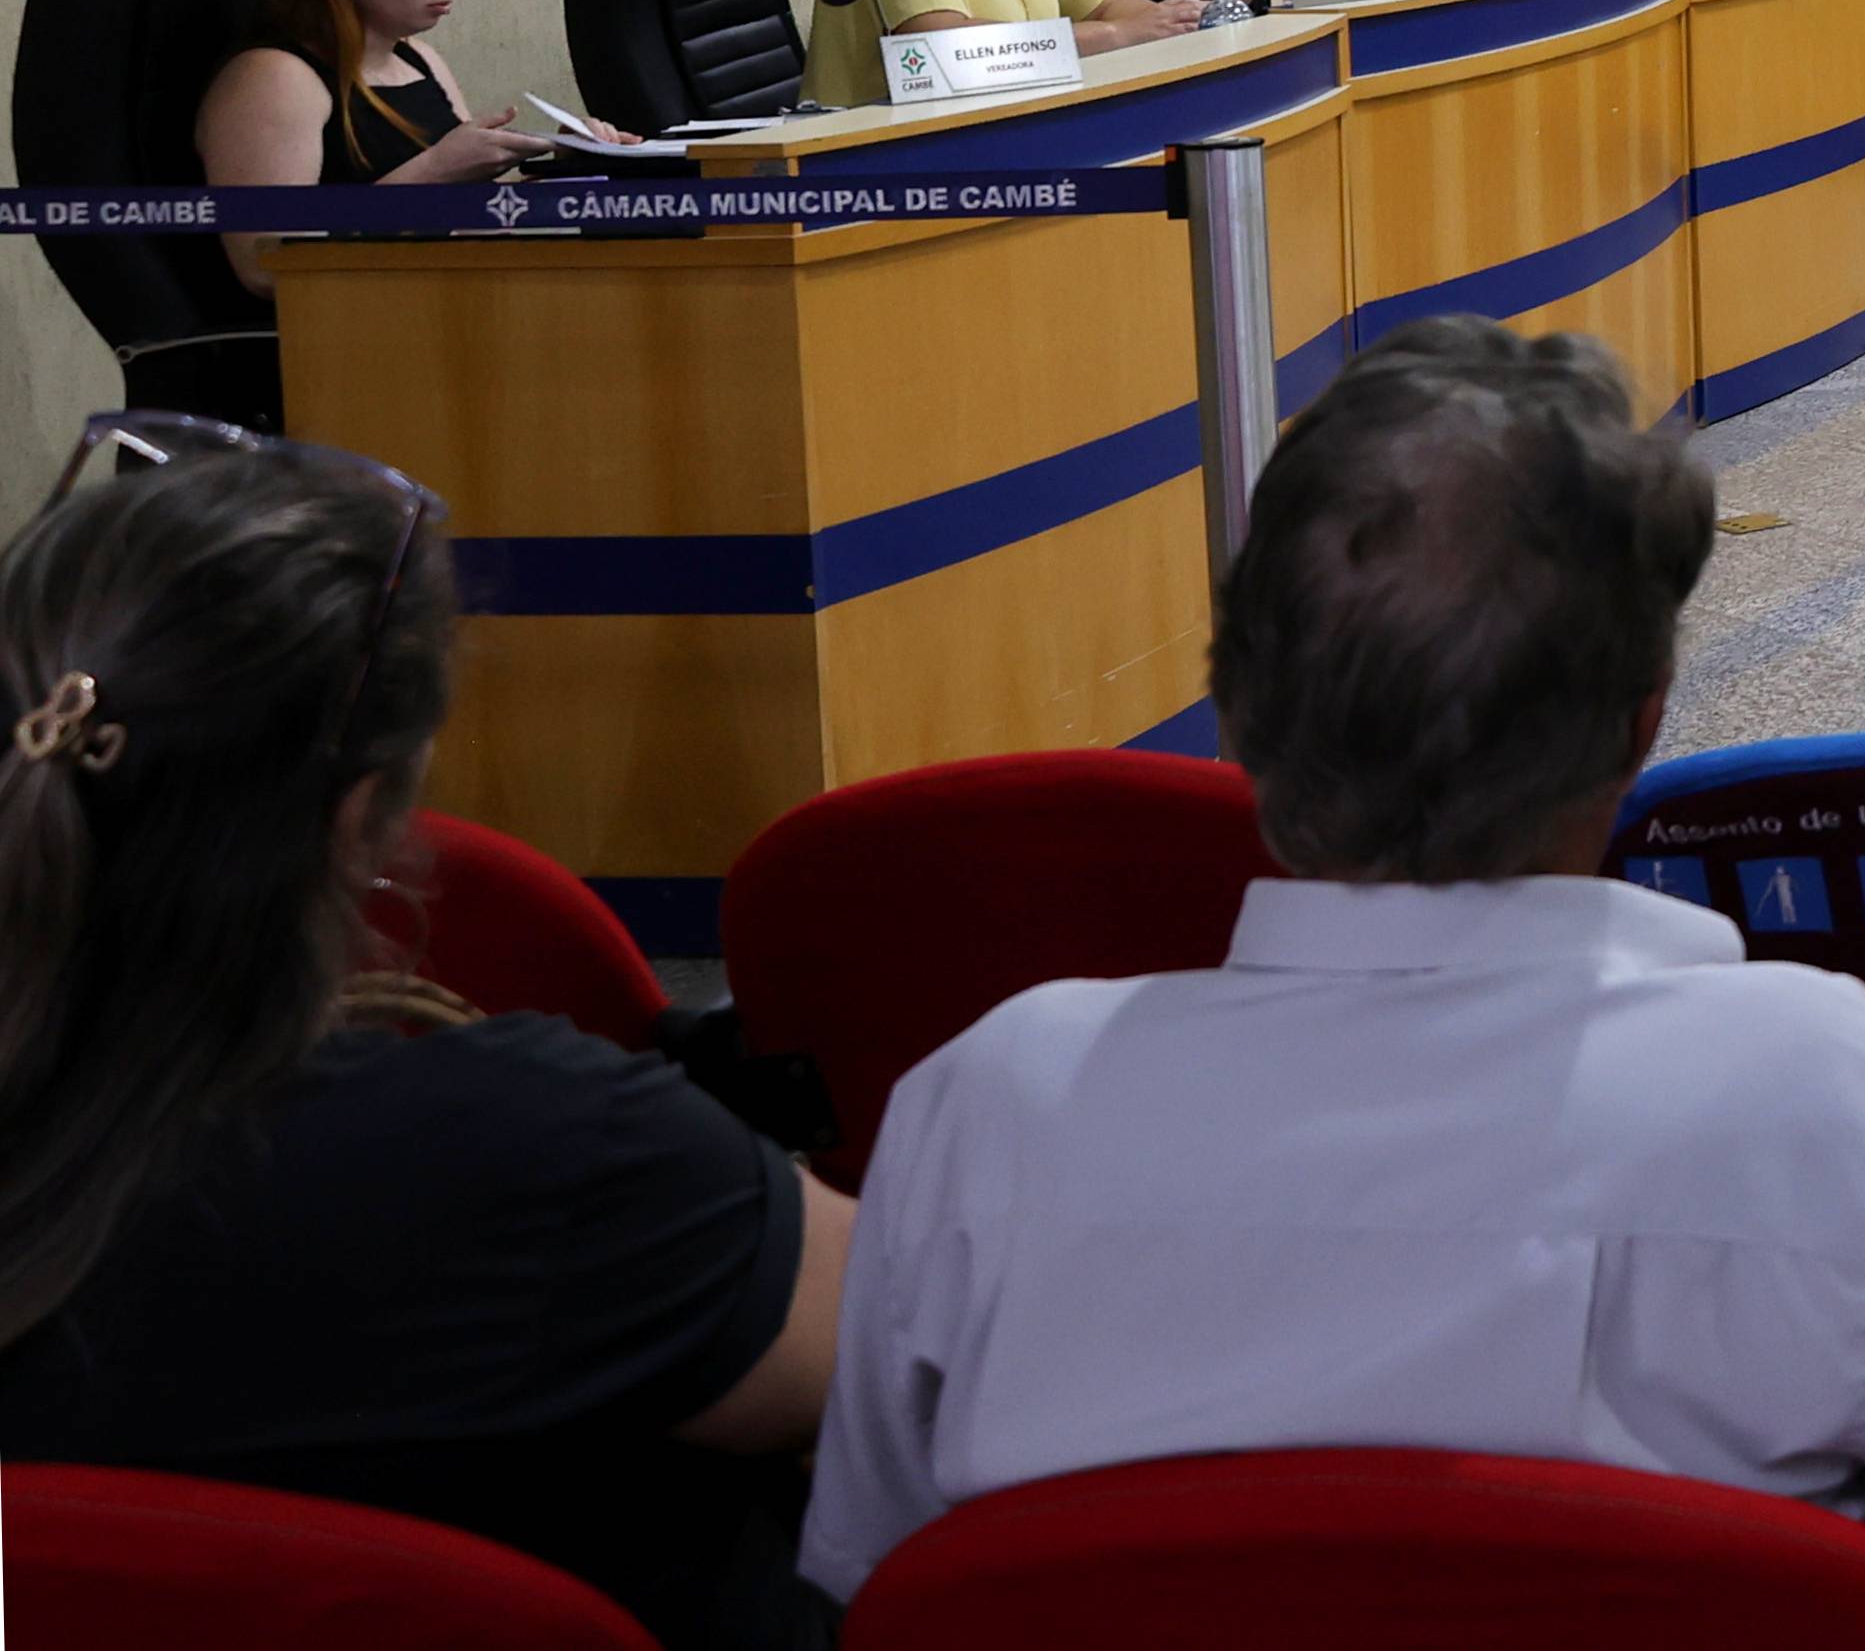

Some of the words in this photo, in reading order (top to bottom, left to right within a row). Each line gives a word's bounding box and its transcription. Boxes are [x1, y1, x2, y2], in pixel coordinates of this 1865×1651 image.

[955, 46, 994, 61] ELLEN
[998, 38, 1057, 56] AFFONSO
[45, 202, 90, 225] DE
[100, 196, 216, 225] CAMBÉ
[558, 190, 700, 219] CÂMARA
[711, 190, 895, 216] MUNICIPAL
[905, 187, 949, 211] DE
[959, 178, 1077, 210] CAMBÉ
[1800, 807, 1842, 831] de
